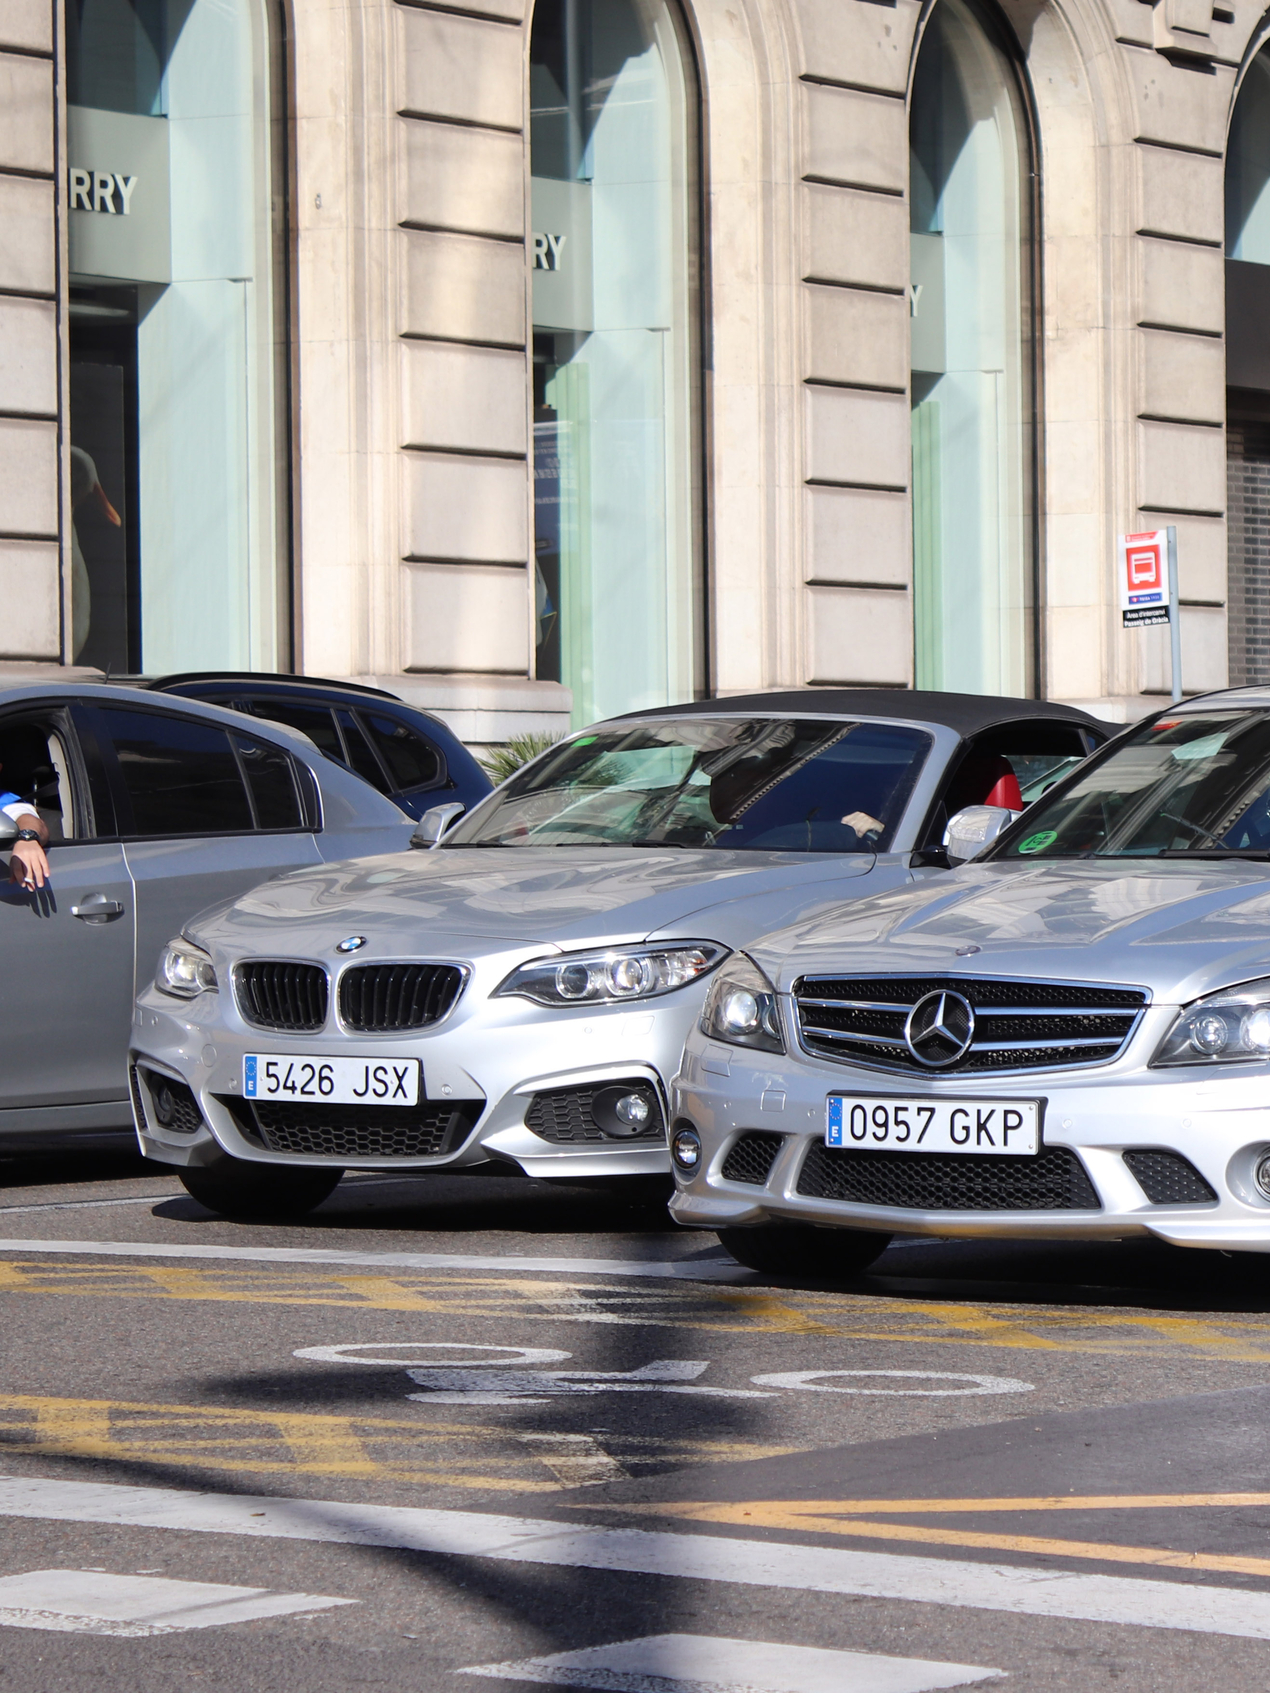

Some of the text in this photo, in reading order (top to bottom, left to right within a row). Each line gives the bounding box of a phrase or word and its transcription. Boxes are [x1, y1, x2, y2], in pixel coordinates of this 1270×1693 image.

[248, 1061, 409, 1099] E 5426 JSX
[831, 1104, 1024, 1147] E 0957 GKP
